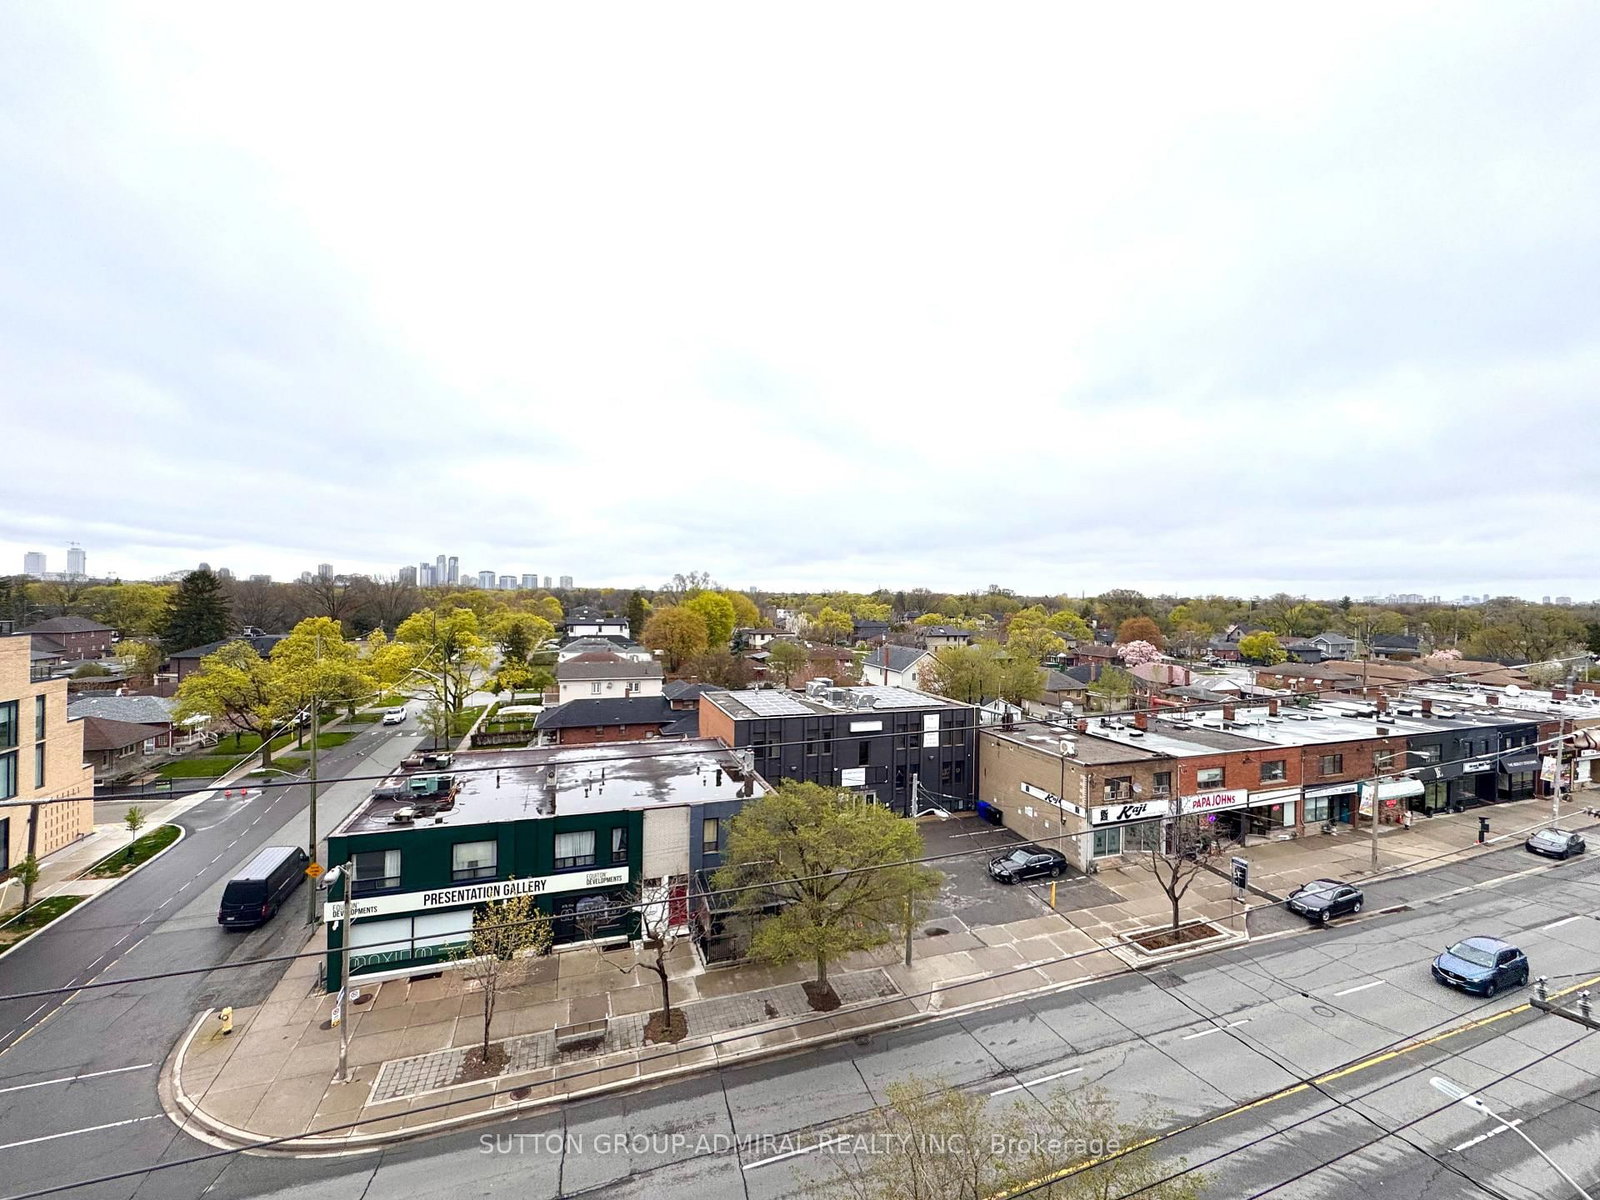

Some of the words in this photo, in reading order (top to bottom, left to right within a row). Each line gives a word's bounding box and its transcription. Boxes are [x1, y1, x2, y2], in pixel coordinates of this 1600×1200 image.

[1193, 797, 1211, 809] PAPA
[1116, 803, 1148, 821] Kaji
[586, 875, 623, 886] DEVELOPMENTS
[423, 885, 501, 906] PRESENTATION
[503, 879, 547, 896] GALLERY
[332, 906, 378, 918] DEVOPMENTS
